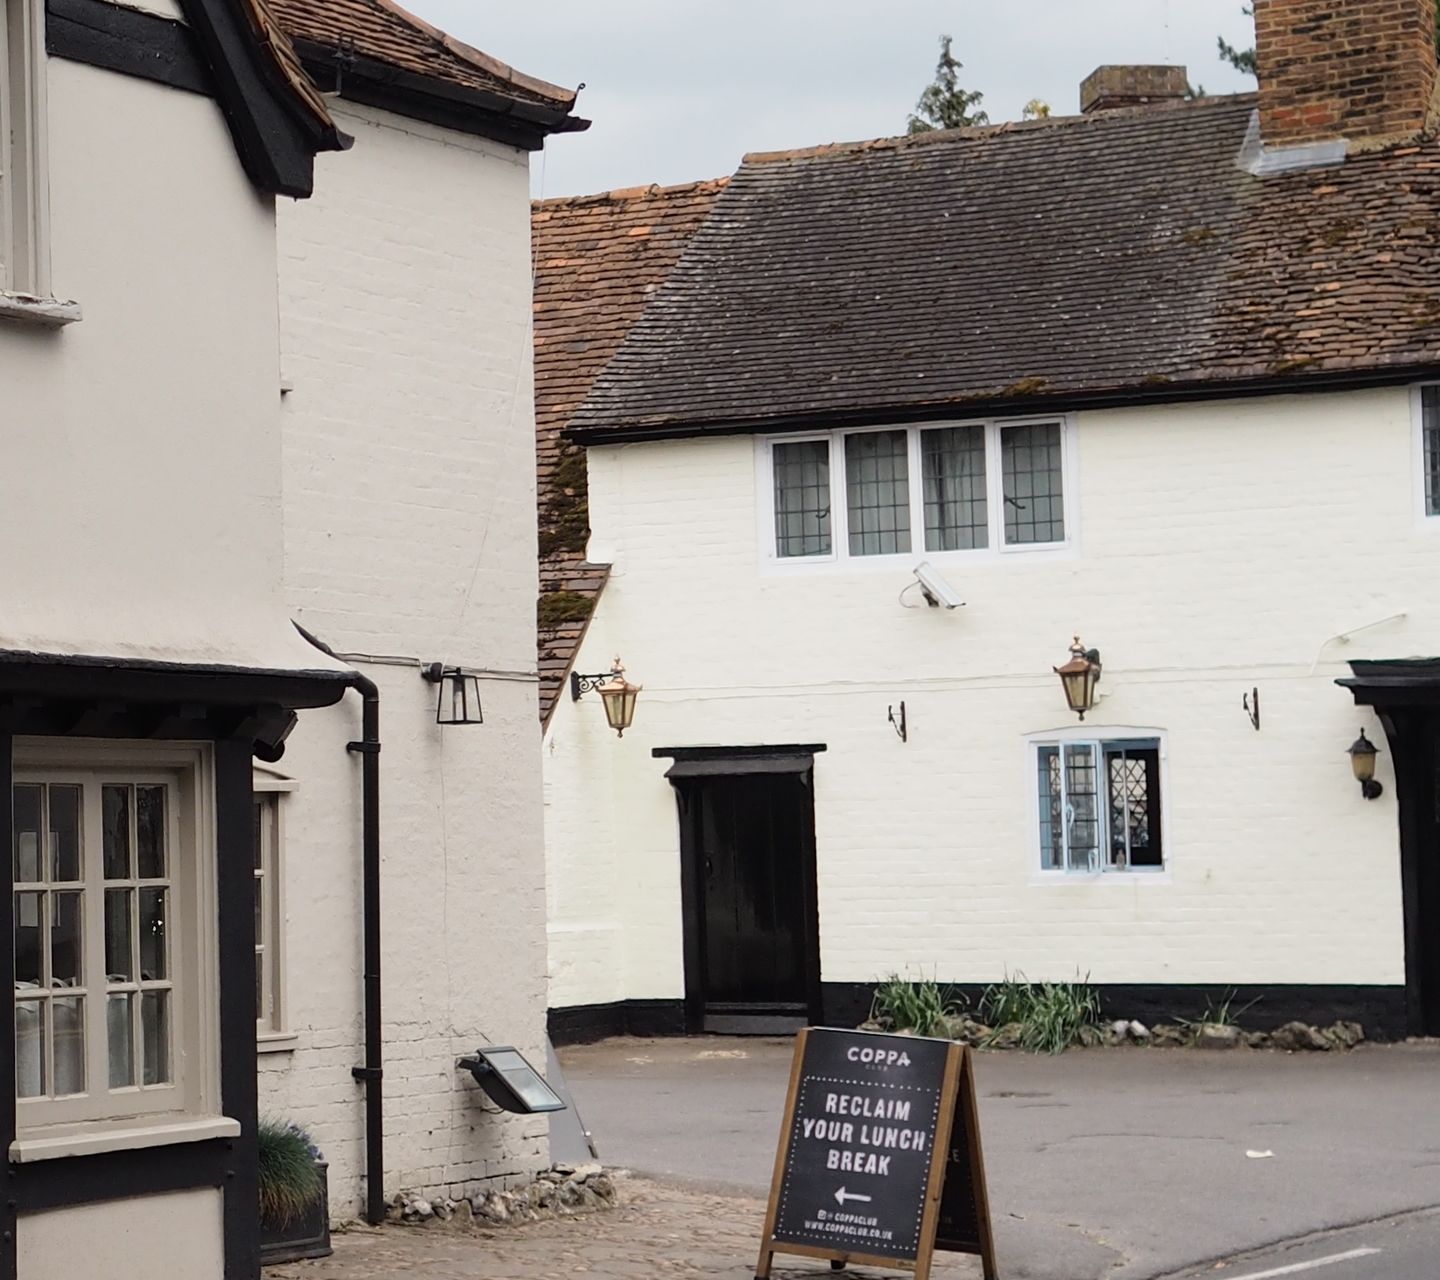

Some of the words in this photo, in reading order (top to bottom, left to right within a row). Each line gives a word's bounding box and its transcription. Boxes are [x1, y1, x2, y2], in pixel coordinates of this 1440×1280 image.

[847, 1046, 911, 1067] COPPA
[825, 1093, 911, 1121] RECLAIM
[803, 1118, 853, 1143] YOUR
[861, 1125, 925, 1151] LUNCH
[827, 1149, 891, 1175] BREAK
